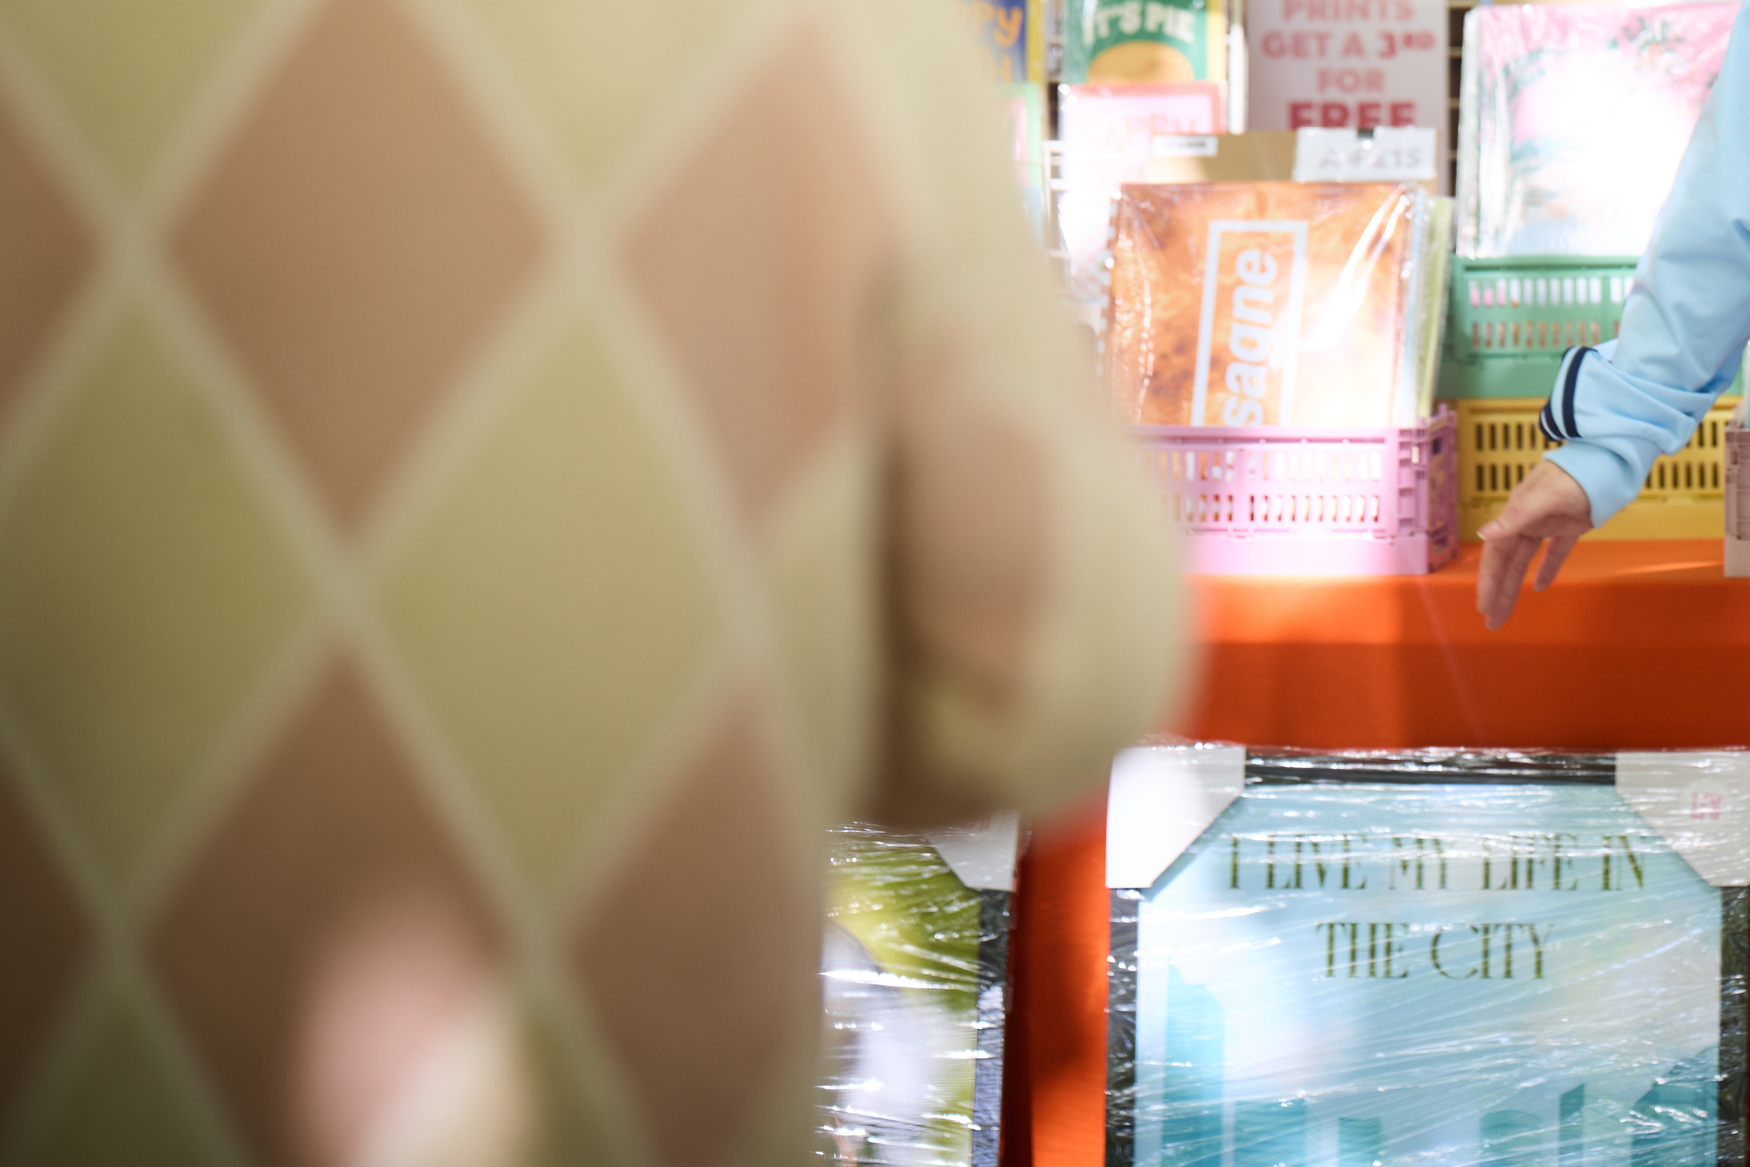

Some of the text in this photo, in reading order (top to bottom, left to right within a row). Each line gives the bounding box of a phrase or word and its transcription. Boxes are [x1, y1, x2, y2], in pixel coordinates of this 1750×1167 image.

[1145, 1, 1198, 44] PIE
[1261, 32, 1436, 59] GET A 3RD
[1316, 69, 1385, 94] FOR
[1288, 102, 1416, 129] FREE
[1228, 835, 1648, 891] I LIVE MY LIFE IN
[1316, 921, 1554, 979] THE CITY
